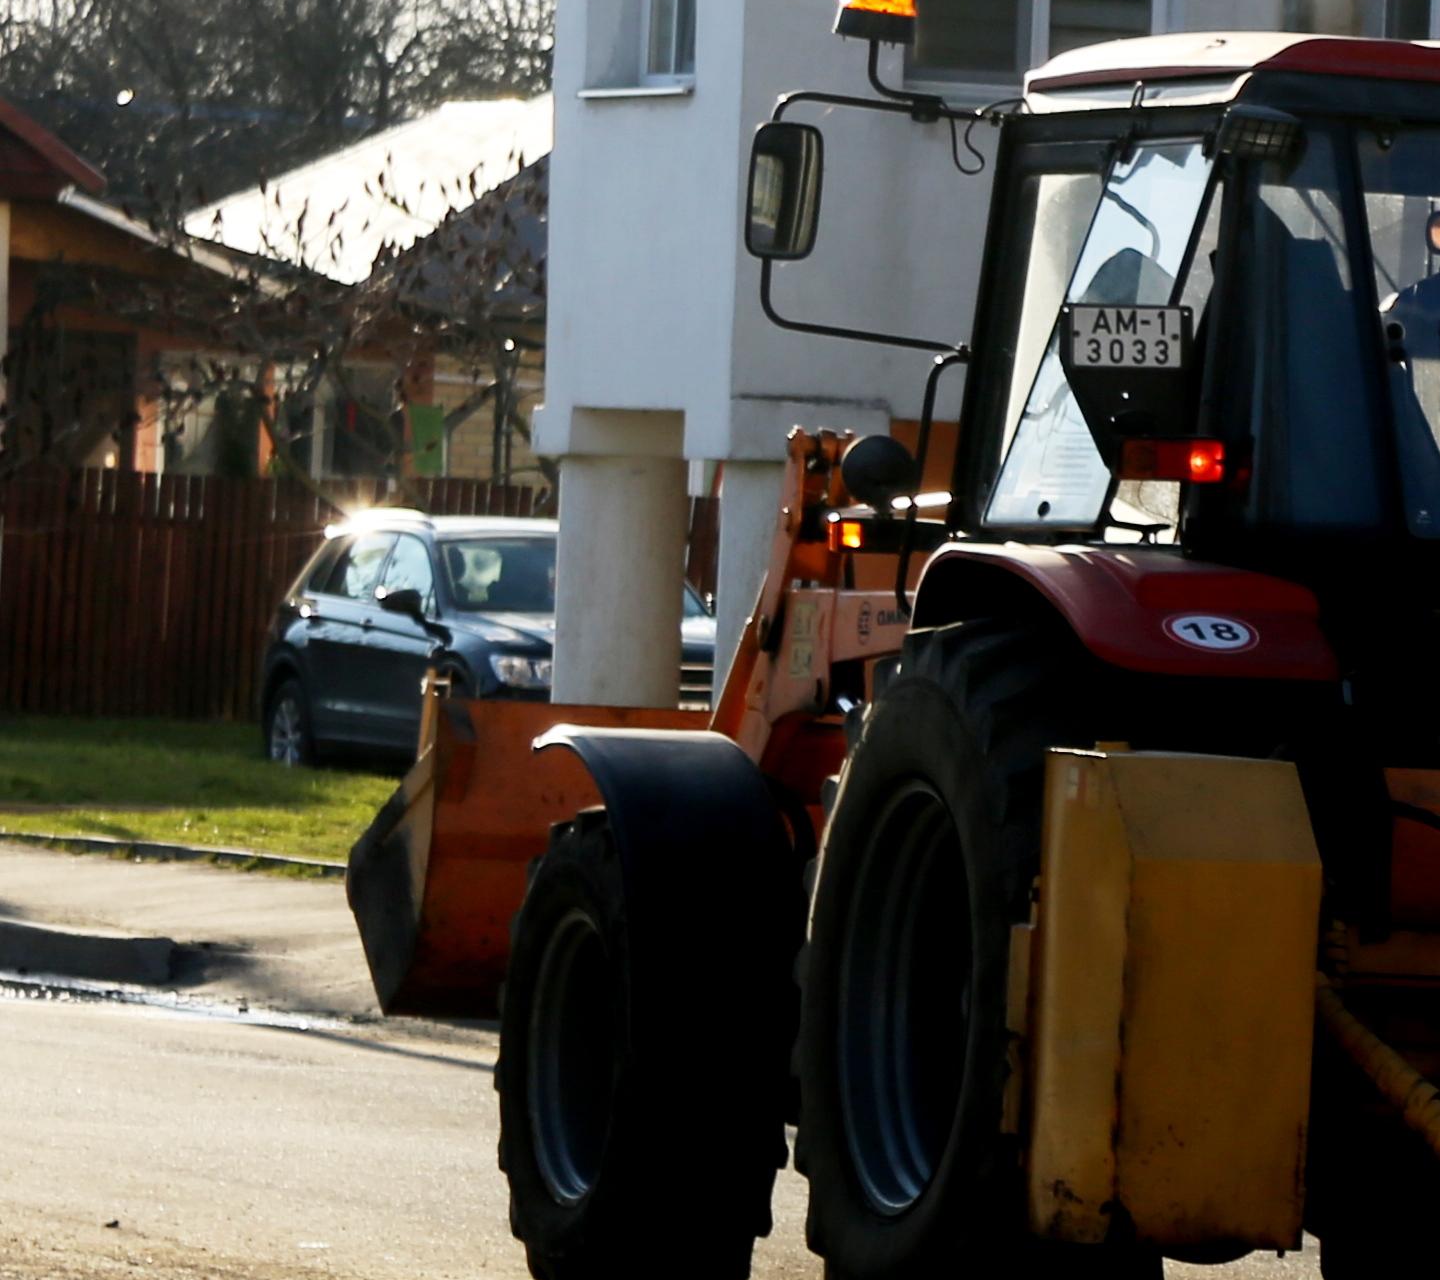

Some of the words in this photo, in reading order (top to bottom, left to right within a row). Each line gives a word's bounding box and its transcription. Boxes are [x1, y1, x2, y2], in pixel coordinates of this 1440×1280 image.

[1091, 308, 1167, 336] AM-1
[1086, 337, 1170, 365] 3033
[1182, 622, 1241, 642] 18
